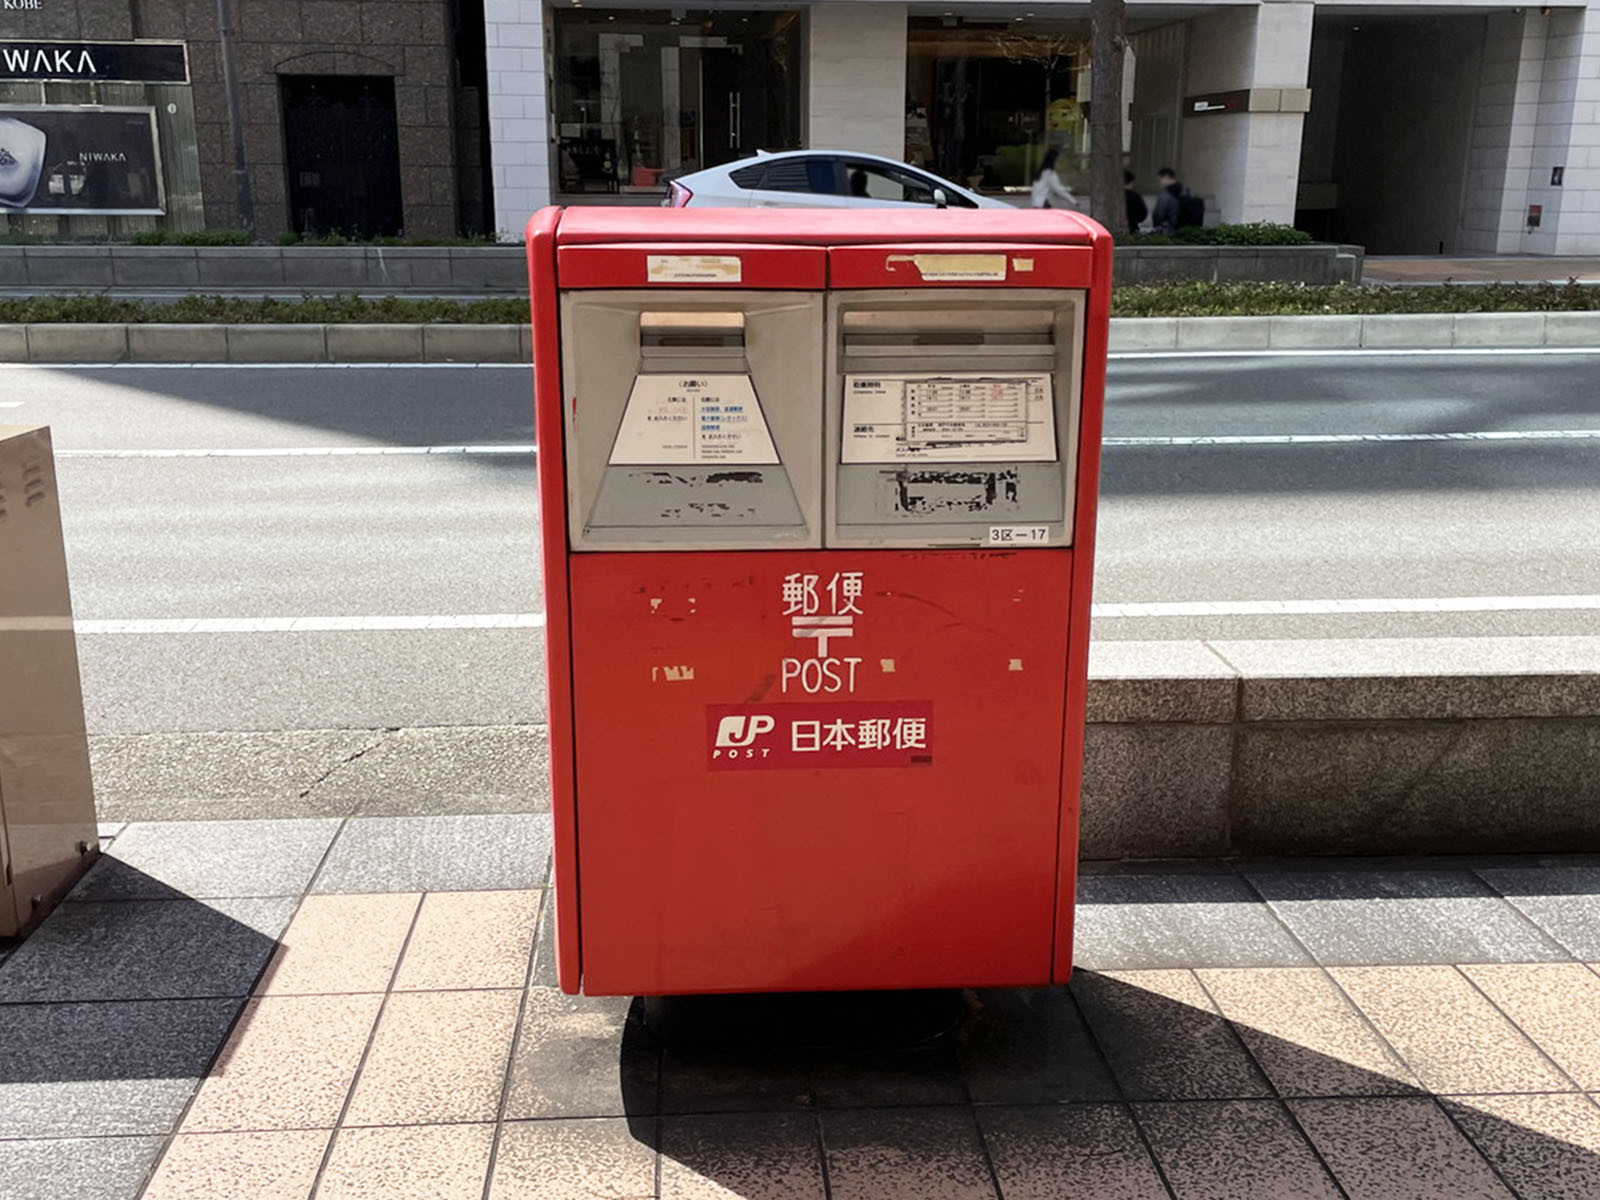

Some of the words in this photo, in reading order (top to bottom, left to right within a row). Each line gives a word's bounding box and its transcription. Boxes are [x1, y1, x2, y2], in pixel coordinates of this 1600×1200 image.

[3, 49, 97, 73] WAKA
[79, 152, 127, 163] NIWAKA
[782, 572, 864, 616] 郵便
[782, 657, 863, 694] POST
[791, 717, 927, 752] 日本郵便
[712, 748, 771, 759] POST
